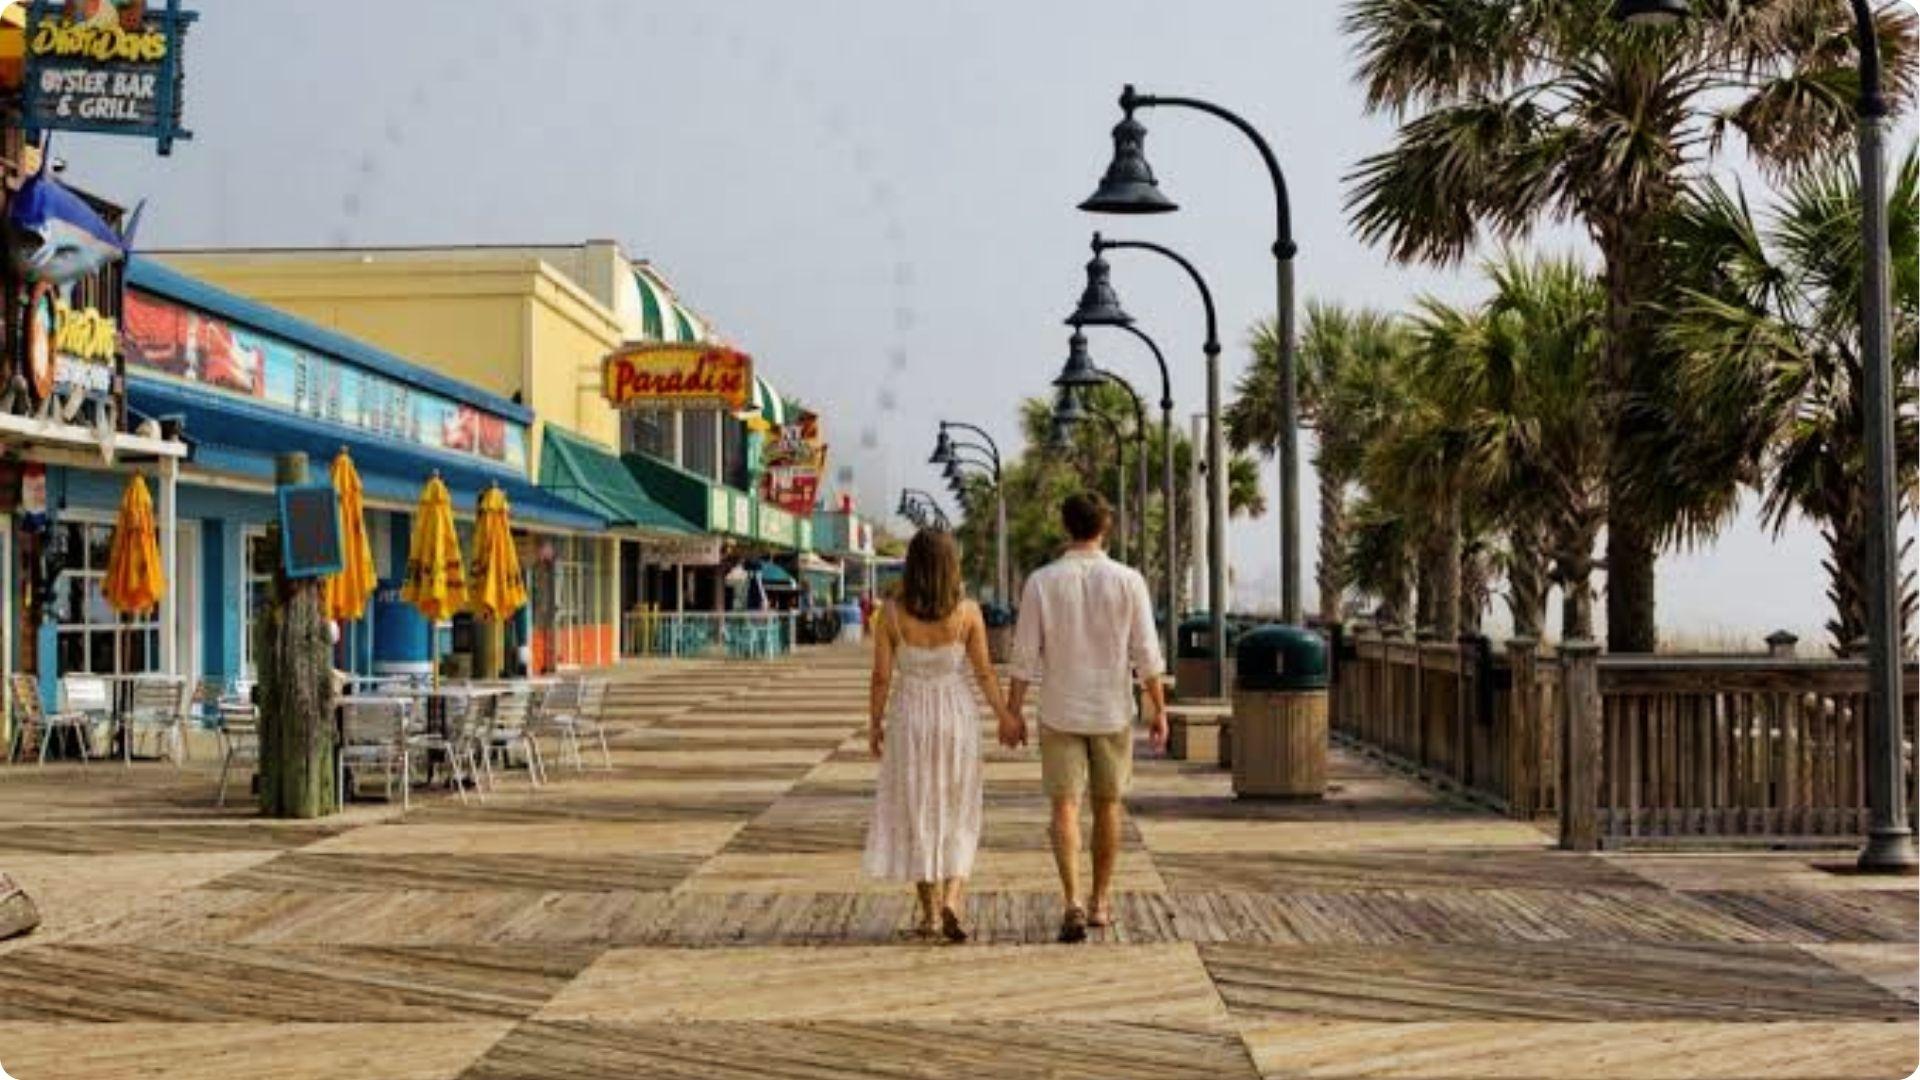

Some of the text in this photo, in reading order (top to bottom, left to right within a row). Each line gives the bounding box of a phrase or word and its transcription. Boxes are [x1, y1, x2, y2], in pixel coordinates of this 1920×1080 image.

[41, 68, 156, 98] OYSTER BAR
[56, 95, 139, 119] & GRILL
[614, 353, 743, 403] Paradise
